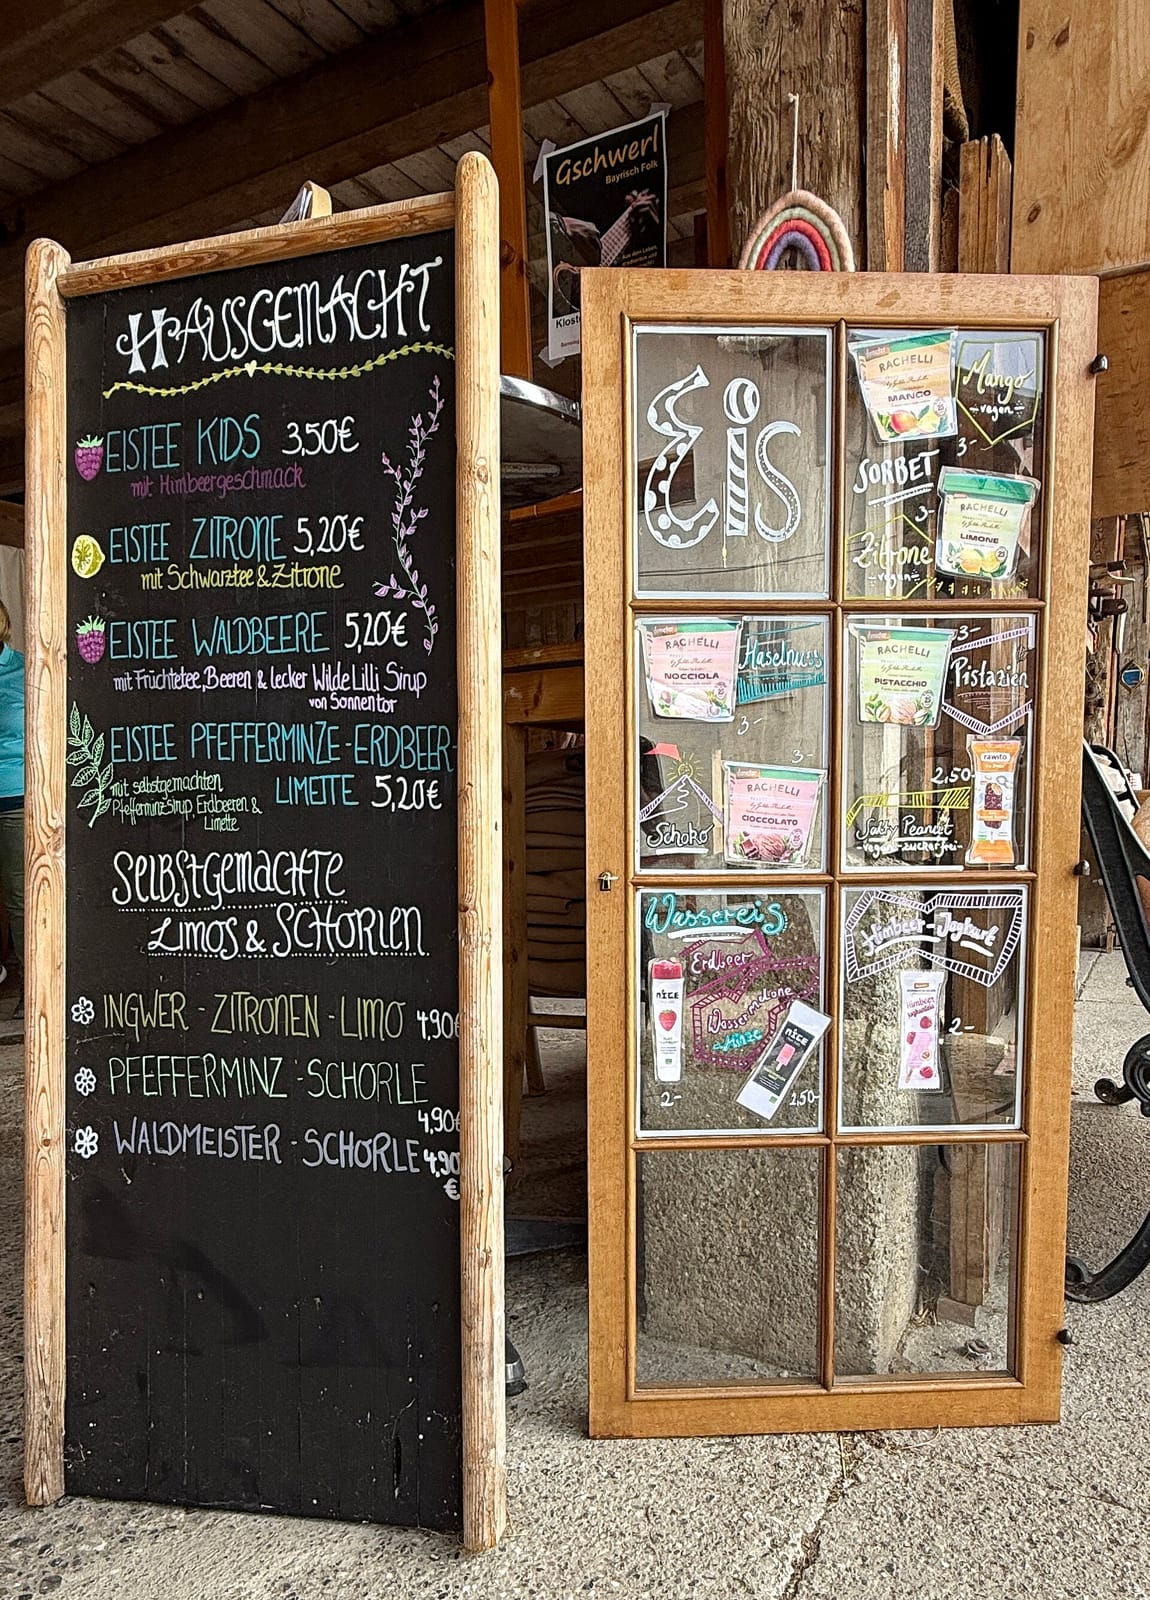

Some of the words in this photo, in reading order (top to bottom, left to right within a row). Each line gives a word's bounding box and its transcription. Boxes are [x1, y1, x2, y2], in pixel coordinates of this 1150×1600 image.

[556, 124, 659, 185] Gschwerl
[605, 166, 640, 185] Bayrisch
[640, 159, 659, 175] Folk
[116, 256, 443, 374] HAUSGEMACHT
[555, 314, 580, 329] Klost
[879, 354, 933, 373] RACHELLI
[963, 350, 1034, 405] Mango
[888, 390, 932, 402] MANGO
[106, 422, 181, 473] EISTEE
[198, 414, 262, 466] KIDS
[282, 416, 360, 457] 3,50€
[644, 364, 801, 549] Eis
[130, 476, 153, 498] mit
[159, 462, 307, 497] Himbeergeschmack
[853, 449, 940, 494] SORBET
[960, 503, 1008, 518] RACHELLI
[110, 522, 172, 564] EISTEE
[189, 514, 288, 562] ZITRONE
[293, 515, 366, 558] 5,20€
[853, 532, 933, 570] Zitrone
[960, 533, 1000, 544] LIMONE
[141, 567, 164, 591] mit
[167, 563, 255, 591] Schwarztee
[257, 566, 271, 587] &
[271, 561, 345, 590] Zitrone
[110, 619, 180, 660] EISTEE
[190, 611, 330, 657] WALDBEERE
[344, 611, 409, 655] 5,20€
[665, 636, 720, 650] RACHELLI
[738, 637, 824, 671] Haselnuss
[877, 644, 931, 658] RACHELLI
[113, 671, 133, 692] mit
[257, 670, 269, 690] &
[270, 664, 308, 690] lecker
[383, 661, 428, 699] Sirup
[664, 672, 720, 680] NOCCIOLA
[874, 677, 928, 688] PISTACCHIO
[951, 656, 1030, 689] Pistazien
[308, 697, 328, 712] von
[110, 723, 178, 764] EISTEE
[983, 753, 1008, 761] rawito
[110, 778, 130, 798] mit
[132, 769, 224, 800] selbstgemachten
[276, 774, 359, 806] LIMETTE
[371, 775, 443, 812] 5,20€
[747, 782, 801, 798] RACHELLI
[196, 794, 249, 815] Erdbeeren
[251, 796, 263, 815] &
[204, 813, 240, 833] Limette
[647, 822, 714, 849] Schoko
[741, 814, 799, 827] CIOCCOLATO
[856, 817, 898, 841] Salty
[902, 815, 954, 836] Peanut
[645, 893, 786, 937] Wassereis
[246, 921, 267, 955] &
[691, 950, 755, 975] Erdbeer
[104, 989, 189, 1042] INGWER
[211, 991, 321, 1039] ZITRONEN
[341, 995, 406, 1042] LIMO
[109, 1053, 288, 1099] PFEFFERMINZ
[307, 1058, 429, 1105] SCHORLE
[113, 1116, 283, 1165] WALDMEISTER
[302, 1129, 420, 1174] SCHORLE
[443, 1177, 461, 1201] €
